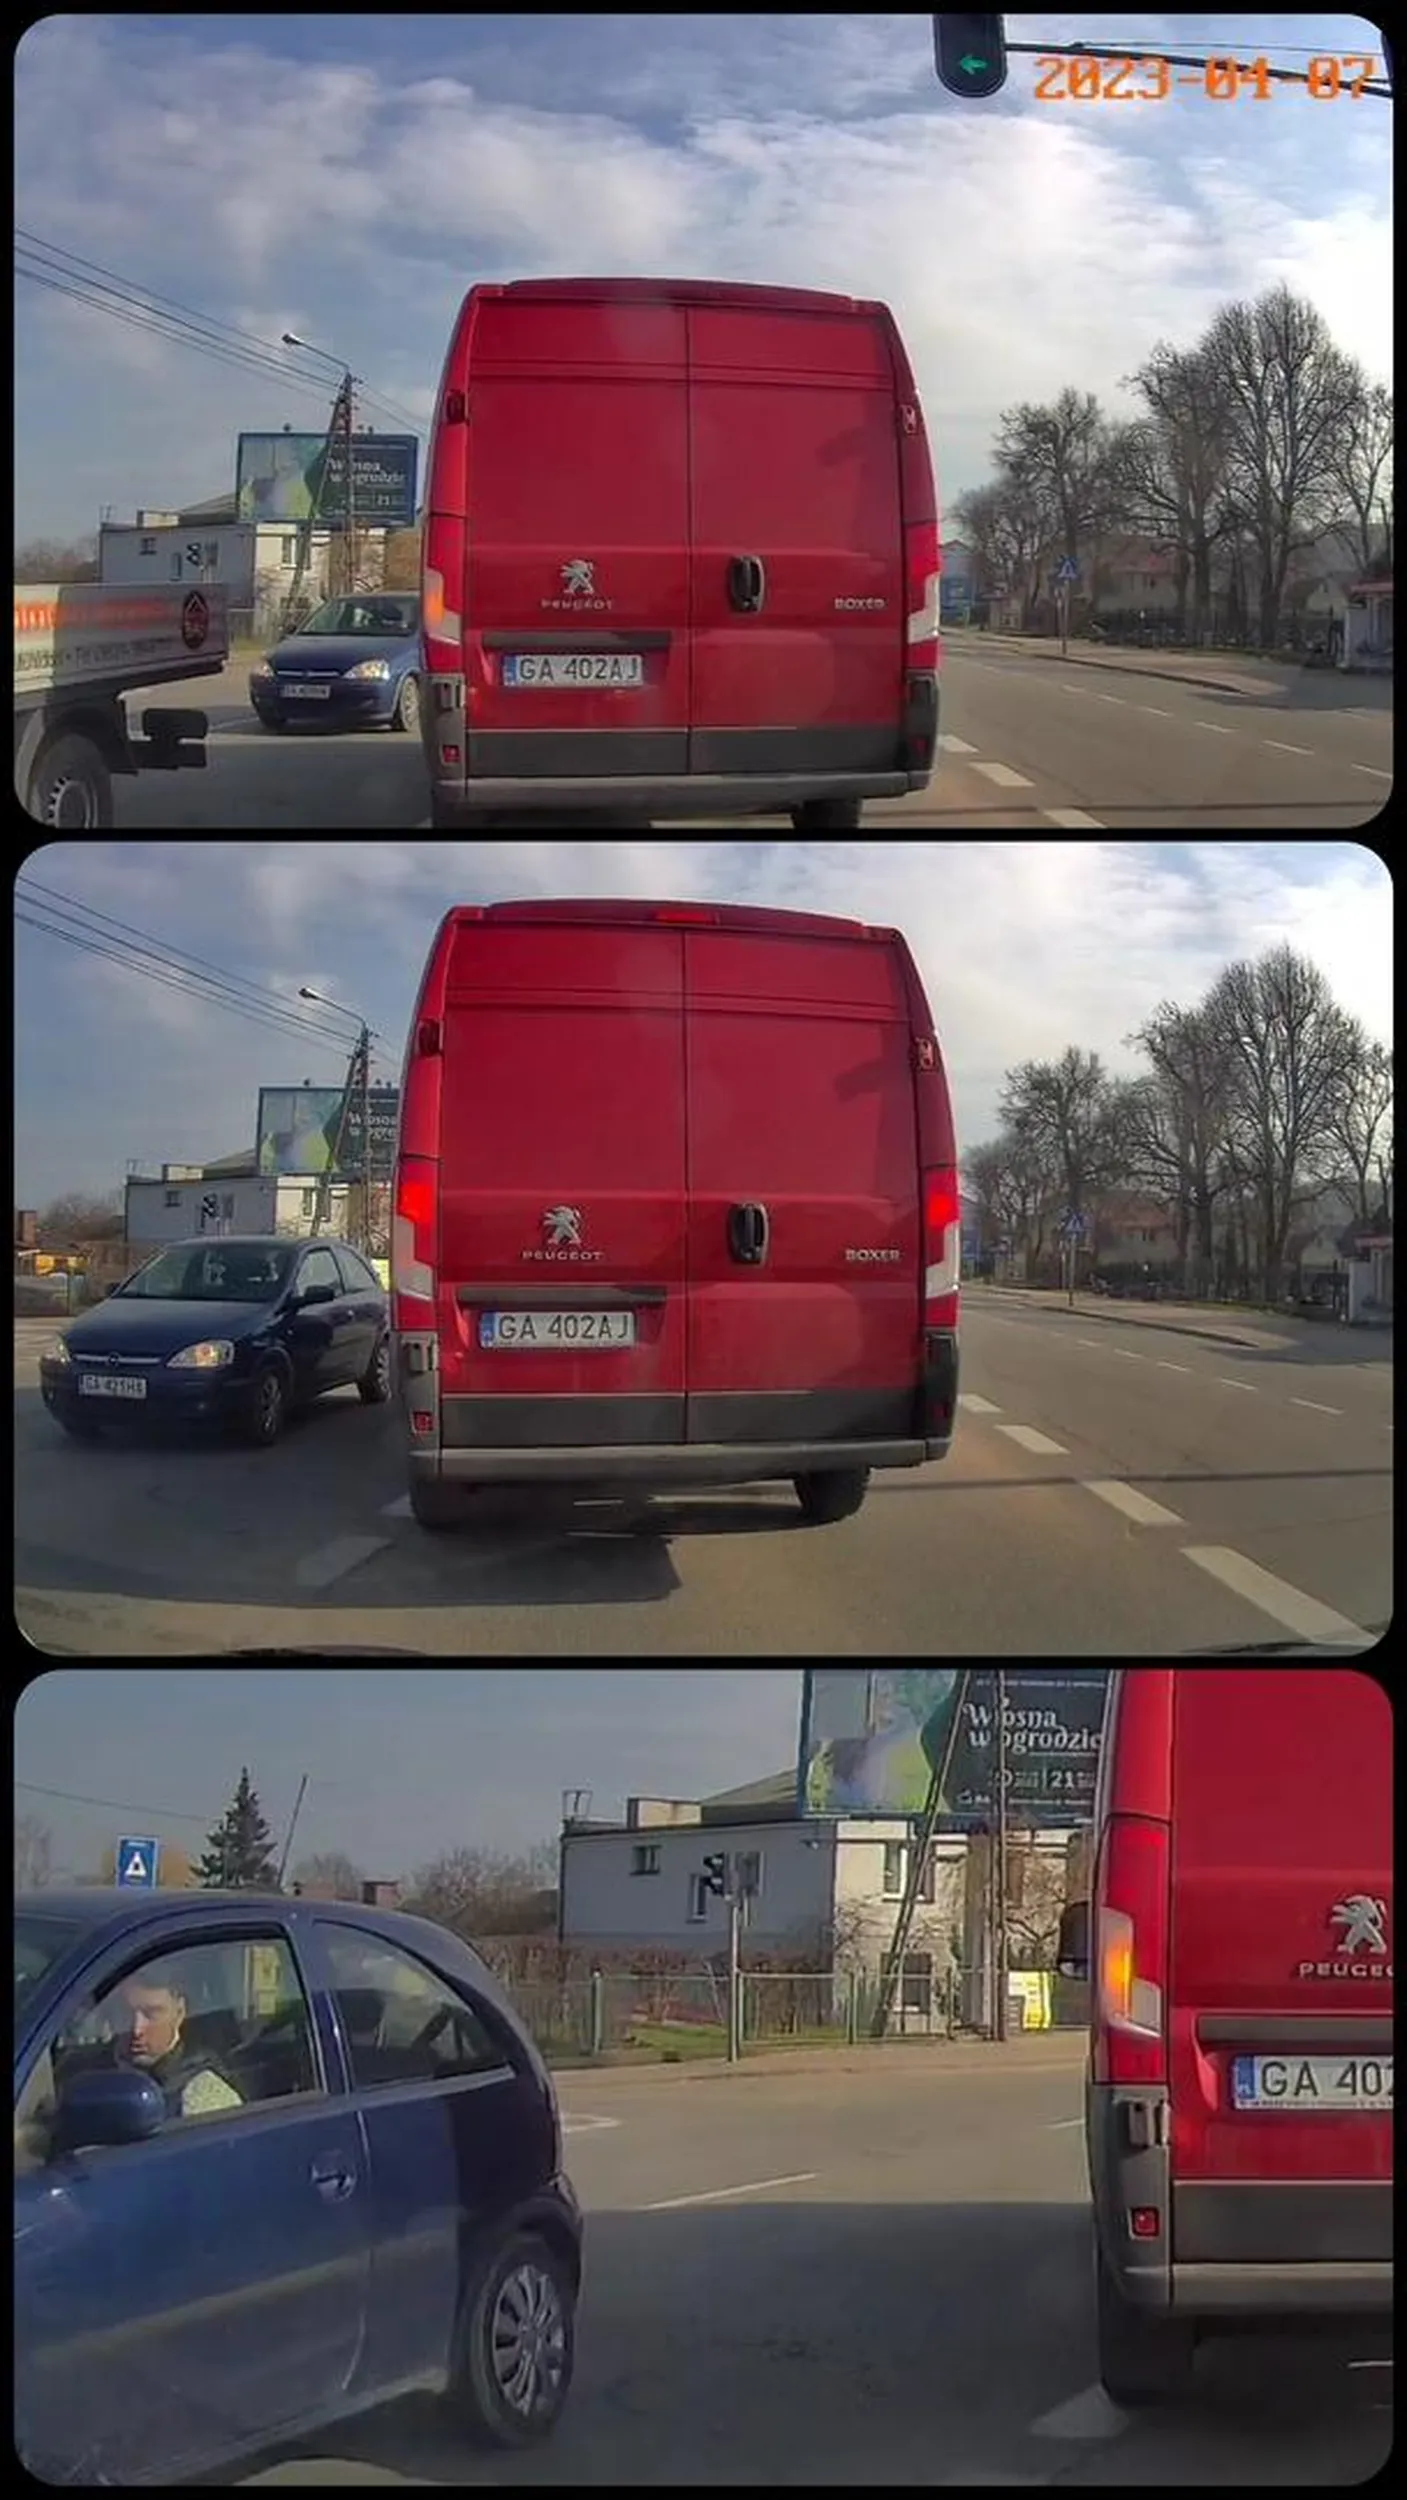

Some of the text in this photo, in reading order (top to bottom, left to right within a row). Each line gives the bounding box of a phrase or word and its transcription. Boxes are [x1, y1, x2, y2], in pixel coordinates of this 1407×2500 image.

[541, 598, 613, 611] PEUGEOT
[834, 597, 885, 610] BOXER
[519, 658, 638, 680] GA 402AJ
[522, 1250, 604, 1261] PEUGEOT
[845, 1249, 900, 1261] BOXER
[499, 1314, 629, 1340] GA 402AJ
[961, 1696, 1057, 1729] Wosna
[969, 1729, 991, 1747] w
[1261, 2060, 1320, 2097] GA
